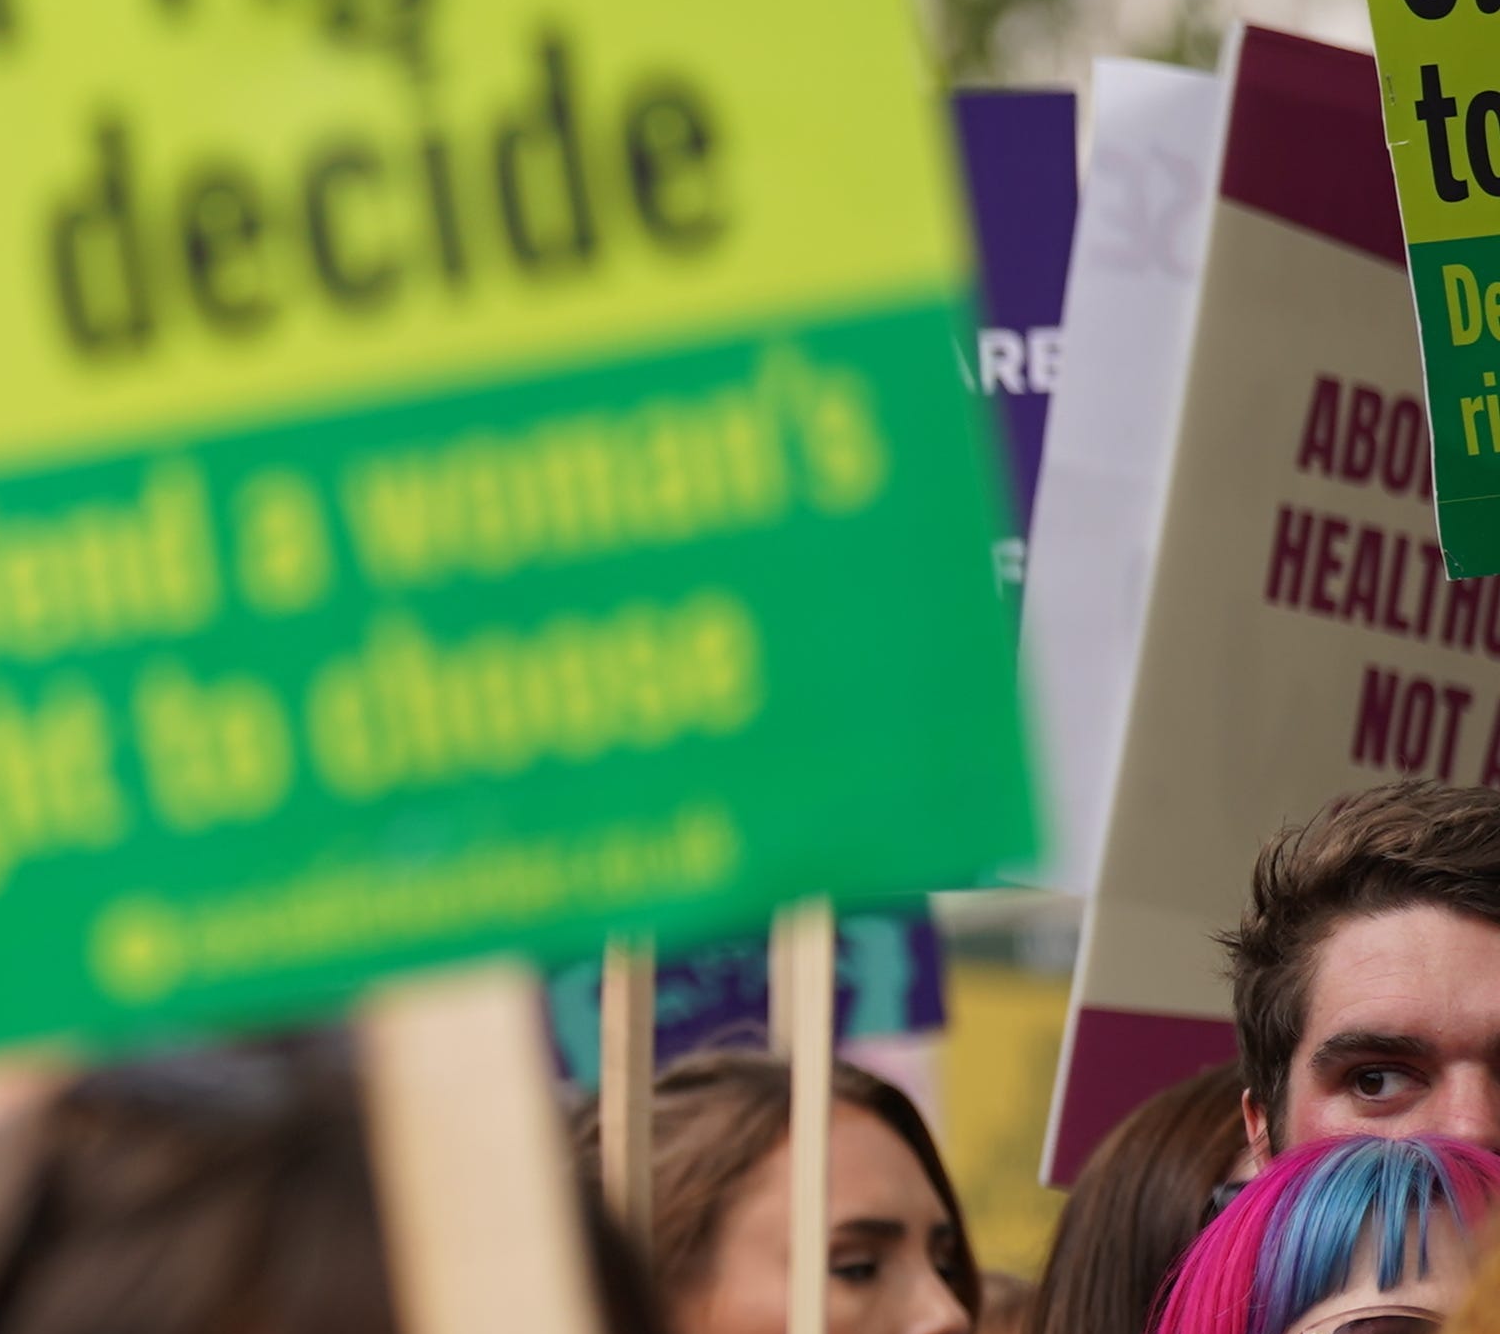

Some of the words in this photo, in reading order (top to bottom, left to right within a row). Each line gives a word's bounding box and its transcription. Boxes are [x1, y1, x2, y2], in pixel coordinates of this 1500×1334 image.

[49, 26, 732, 371] decide
[1297, 374, 1433, 505] ABO
[1352, 665, 1473, 783] NOT
